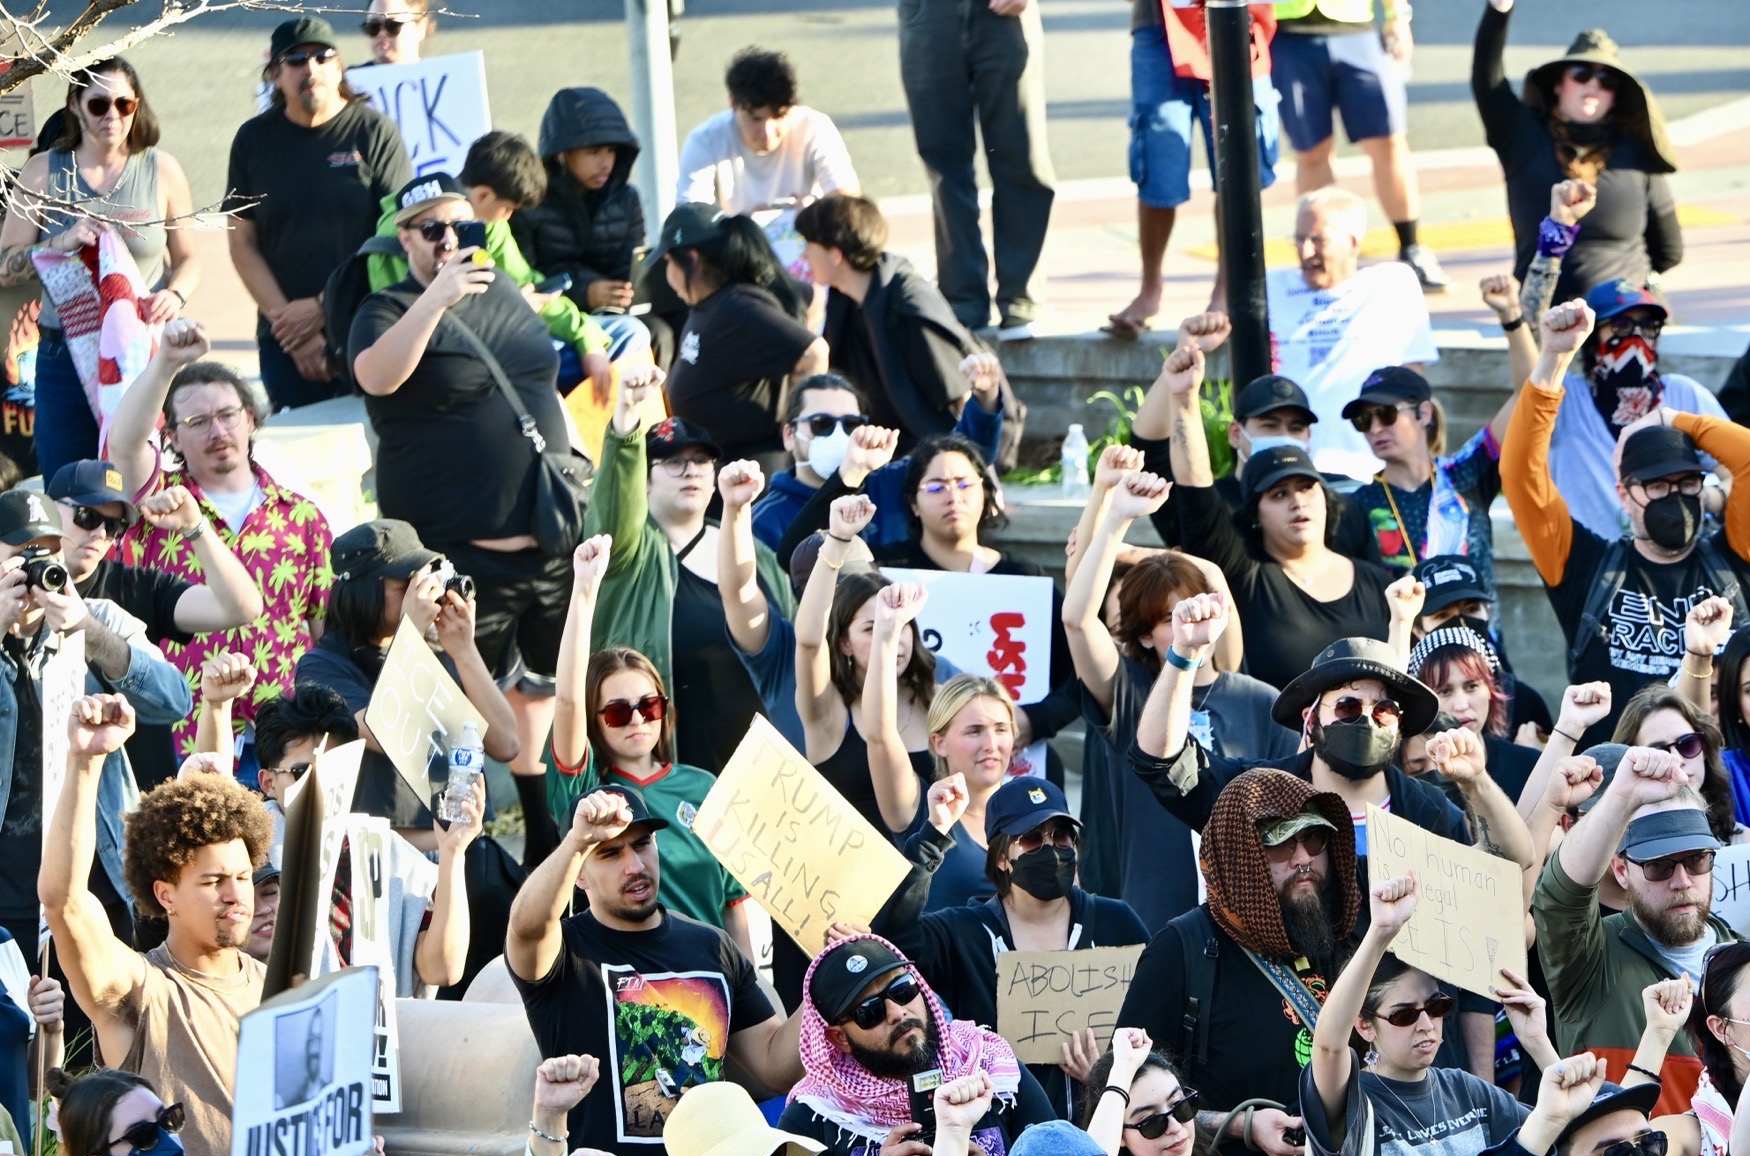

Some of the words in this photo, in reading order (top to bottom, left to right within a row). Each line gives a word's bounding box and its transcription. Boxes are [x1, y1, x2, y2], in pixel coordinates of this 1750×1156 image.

[393, 634, 456, 737] ICE
[751, 735, 866, 858] TRUMP
[776, 810, 801, 844] IS
[723, 788, 841, 921] KILLING
[1373, 811, 1406, 859] No
[1423, 831, 1497, 897] human
[751, 870, 811, 938] ALL!
[1418, 871, 1459, 916] legal
[1008, 961, 1132, 999] ABOLISH
[1017, 1010, 1116, 1043] ICE
